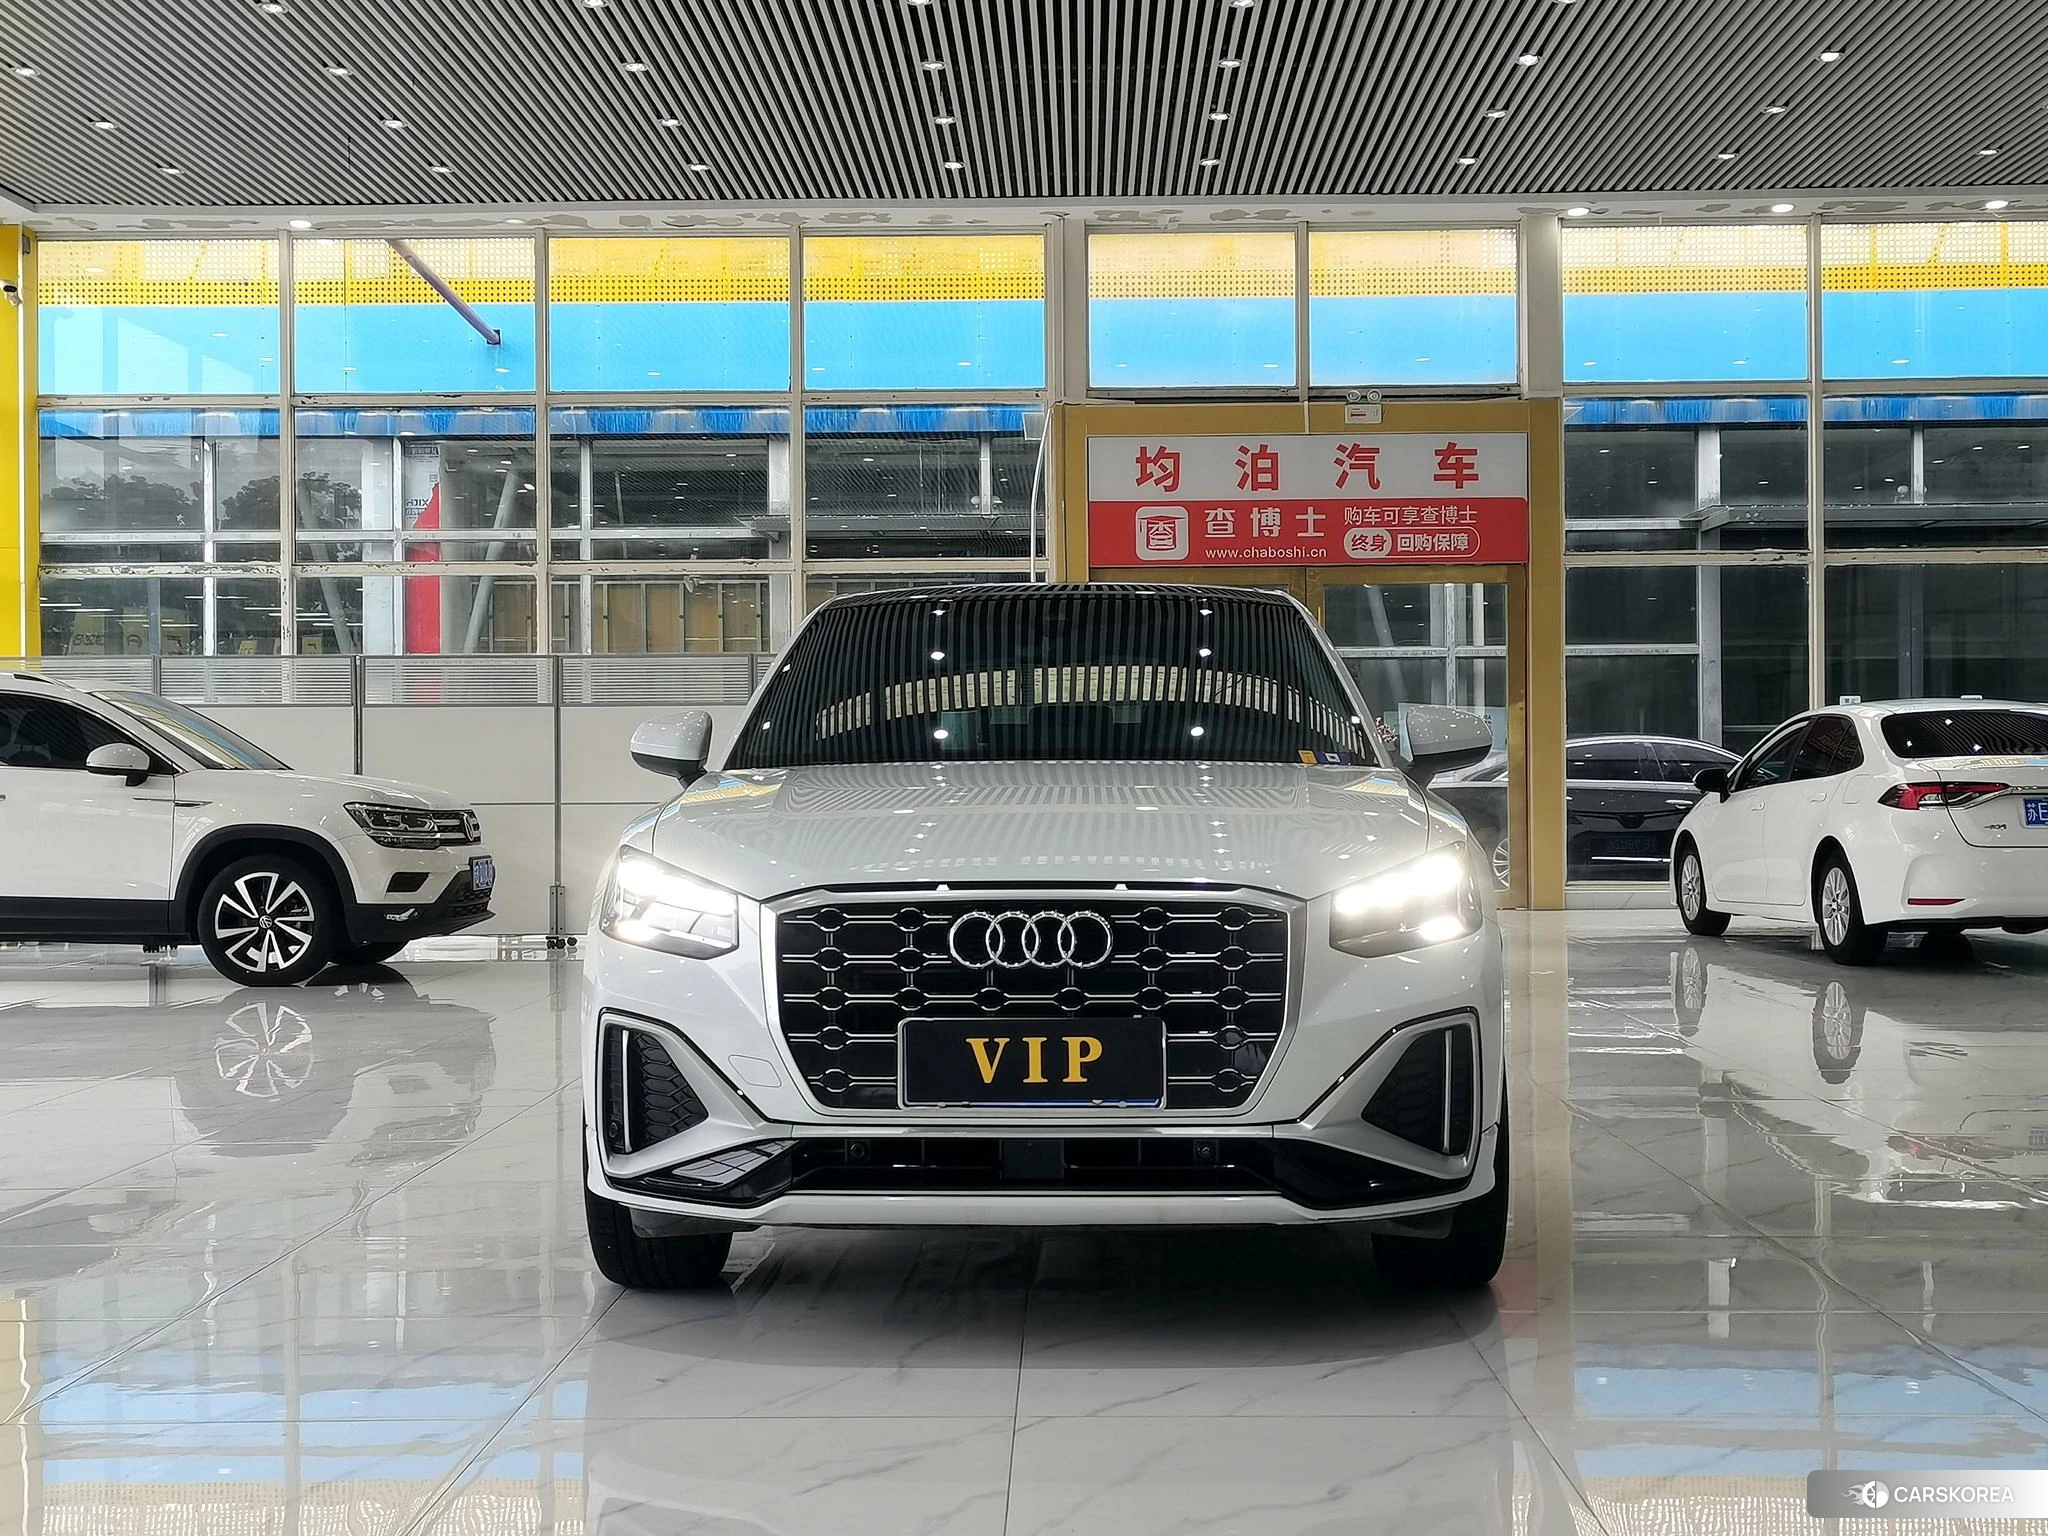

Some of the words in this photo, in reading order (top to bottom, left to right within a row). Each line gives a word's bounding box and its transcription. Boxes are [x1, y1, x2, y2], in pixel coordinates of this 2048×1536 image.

[1135, 441, 1480, 493] 均泊汽车
[1204, 506, 1327, 538] 查博士
[1344, 505, 1478, 526] 购车可享查博士
[1205, 545, 1327, 559] www.chaboshi.cn
[1351, 533, 1387, 552] 终身
[1397, 532, 1469, 552] 回购保障
[965, 1036, 1103, 1084] VIP
